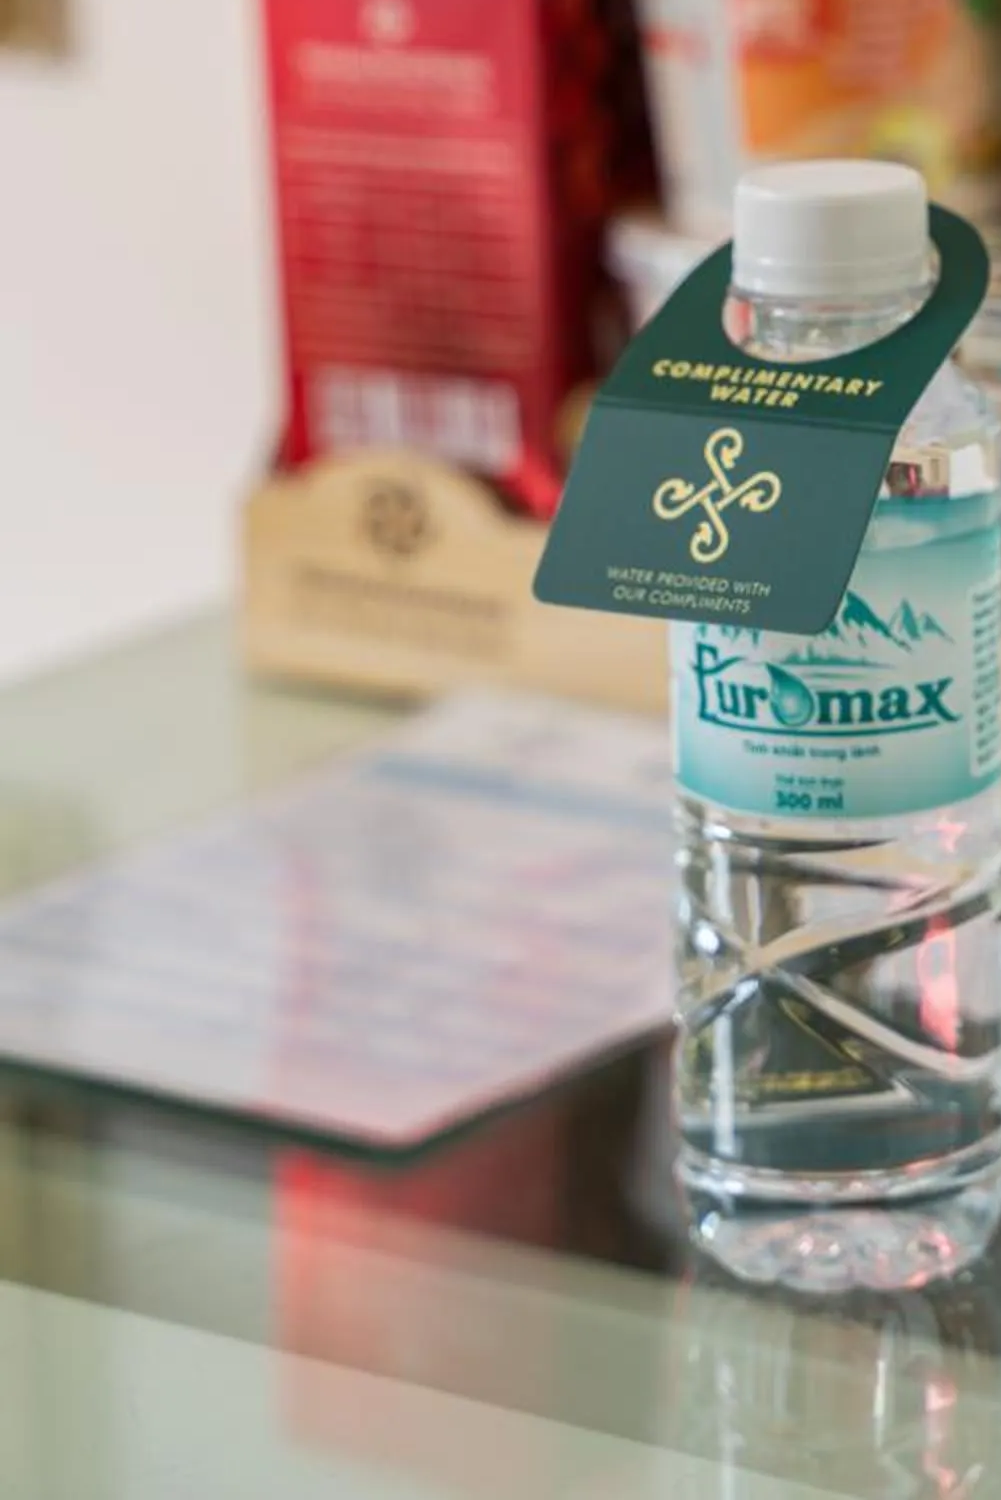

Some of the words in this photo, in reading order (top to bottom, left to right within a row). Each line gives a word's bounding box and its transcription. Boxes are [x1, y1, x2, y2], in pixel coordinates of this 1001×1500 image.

[652, 358, 884, 397] COMPLIMENTARY
[710, 385, 799, 408] WATER
[606, 565, 653, 584] WATER
[656, 570, 729, 595] PROVIDED
[733, 579, 771, 598] WITH
[613, 586, 645, 602] OUR
[649, 590, 750, 614] COMPLIMENTS
[776, 791, 811, 810] 300
[817, 792, 843, 809] ml
